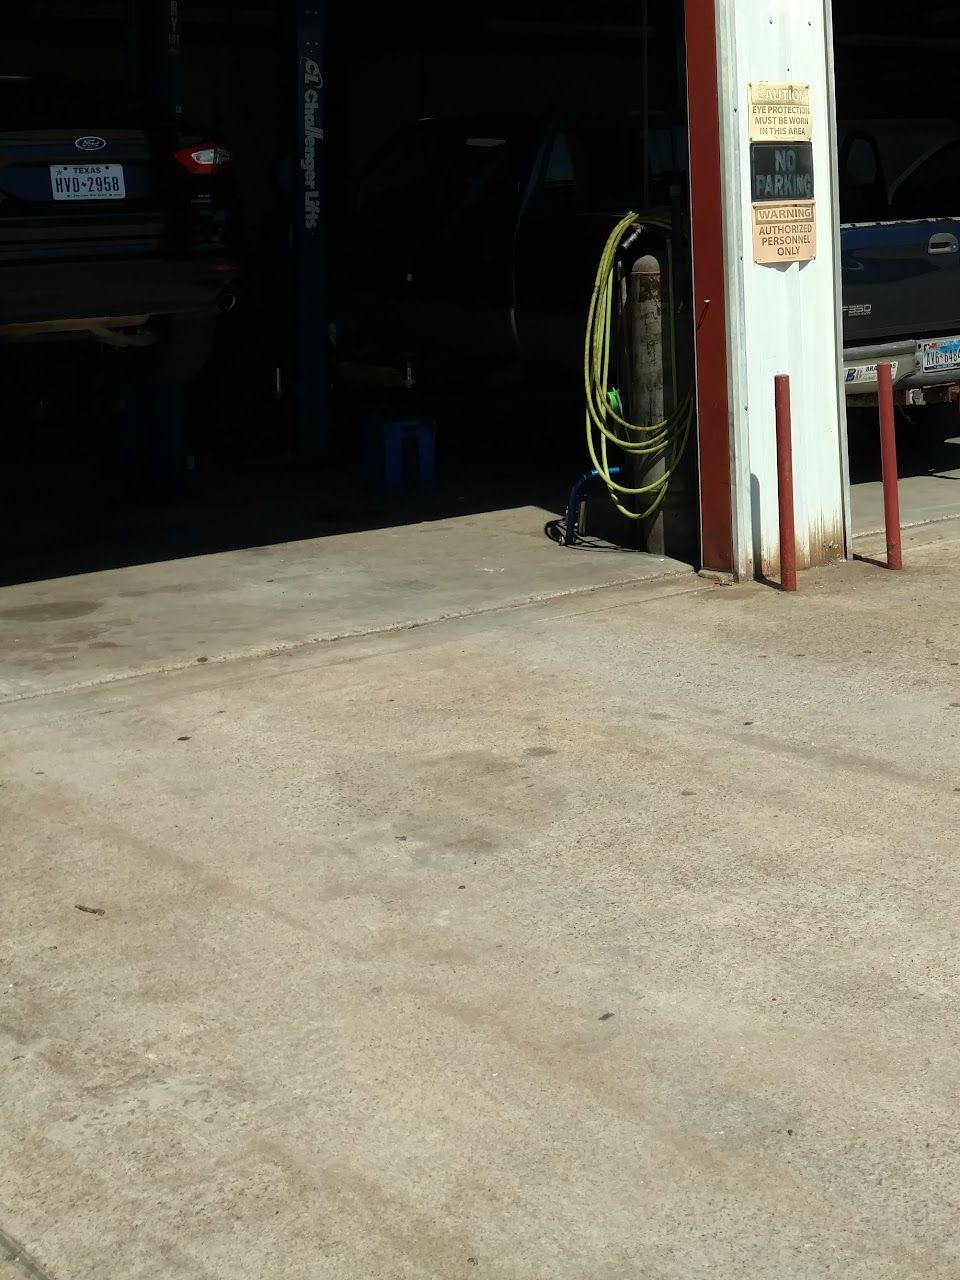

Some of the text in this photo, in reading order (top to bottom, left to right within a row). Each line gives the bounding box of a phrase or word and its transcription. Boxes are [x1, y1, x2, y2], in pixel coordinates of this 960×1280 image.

[752, 106, 810, 115] EYE PROTECTION
[755, 116, 809, 125] MUST BE WORN
[760, 127, 806, 135] IN THIS AREA
[301, 89, 324, 190] Challenger
[775, 149, 796, 172] NO
[755, 172, 812, 197] PARKING
[304, 191, 321, 230] Lifts
[758, 208, 812, 219] WARNING
[758, 224, 813, 236] AUTHORIZED
[761, 235, 811, 246] PERSONNEL
[777, 246, 801, 256] ONLY
